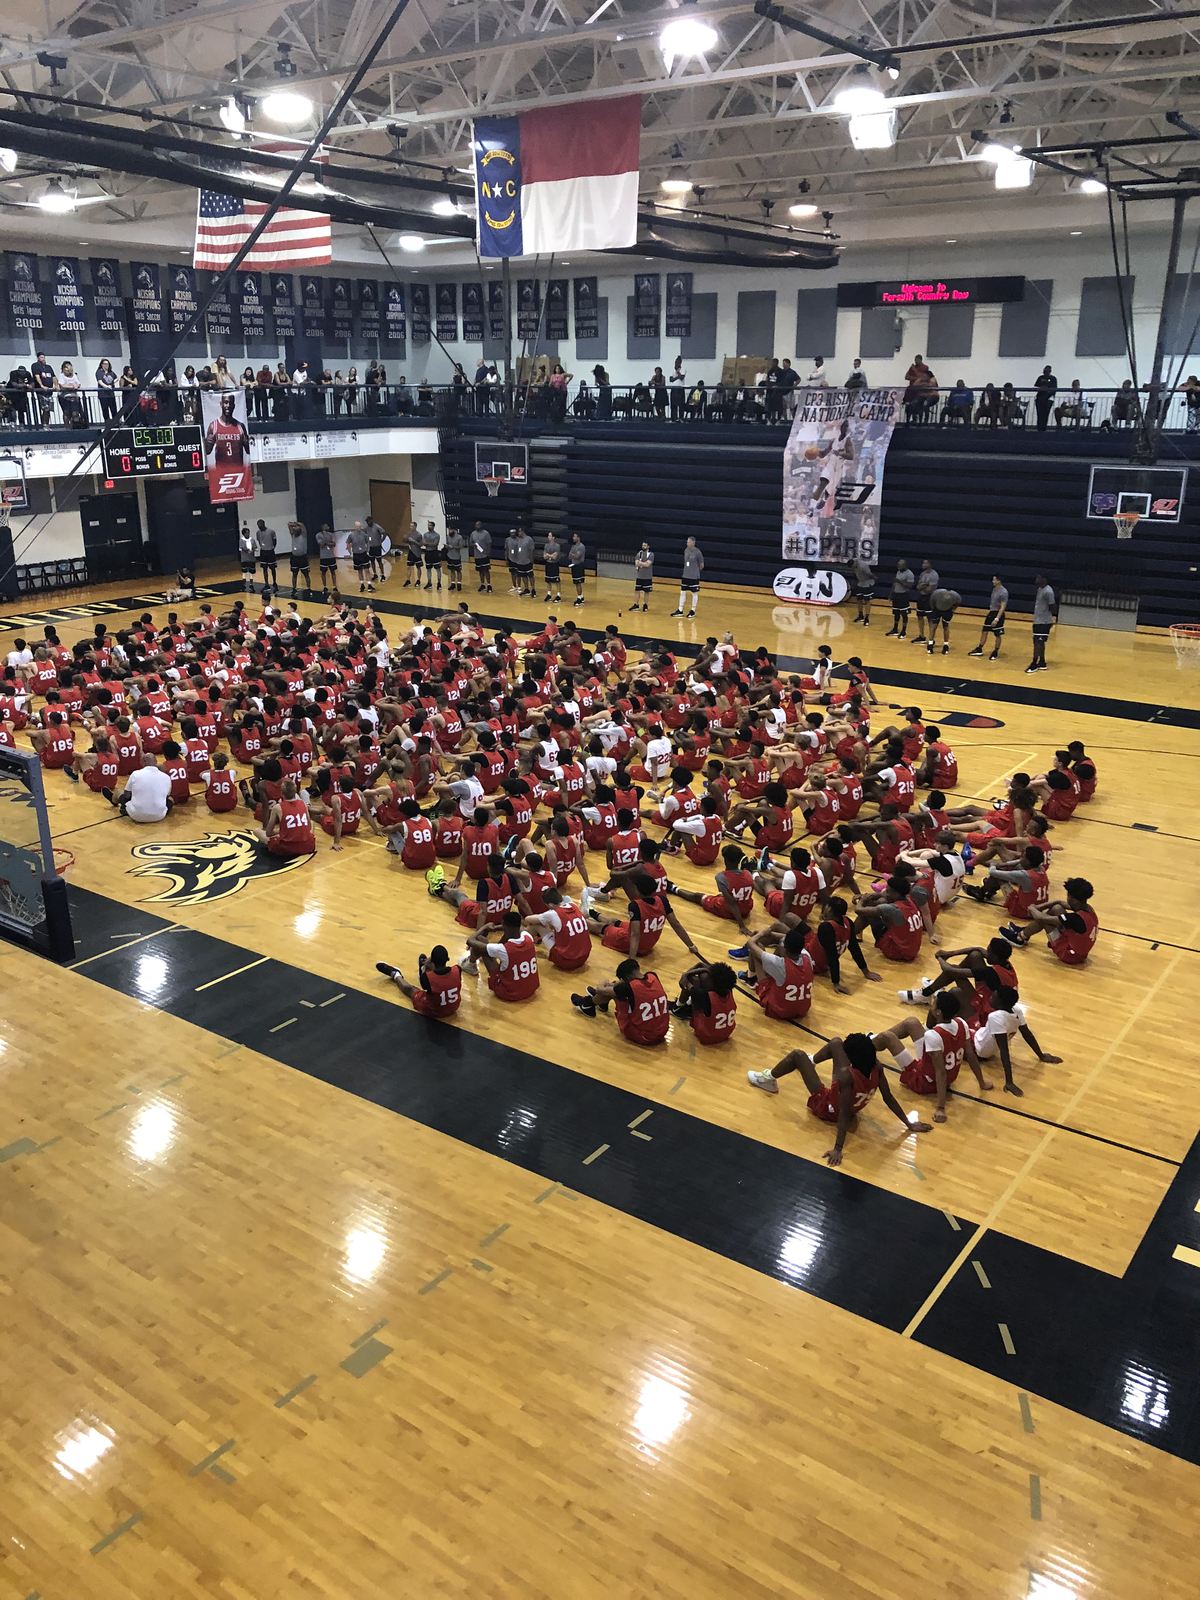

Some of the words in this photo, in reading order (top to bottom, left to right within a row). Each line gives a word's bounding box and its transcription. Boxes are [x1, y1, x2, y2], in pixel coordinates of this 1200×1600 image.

[482, 181, 492, 198] N
[505, 180, 517, 197] C
[901, 284, 934, 292] Welcome
[937, 282, 947, 291] to
[9, 291, 42, 304] CHAMPIONS
[53, 295, 84, 307] CHAMPIONS
[93, 296, 123, 307] CHAMPIONS
[882, 292, 914, 302] Forsyth
[917, 291, 950, 301] Country
[952, 289, 969, 300] Day
[133, 299, 161, 310] CHAMPIONS
[170, 300, 198, 311] CHAMPIONS
[239, 305, 264, 315] CHAMPIONS
[15, 317, 43, 329] 2000
[60, 320, 85, 331] 2000
[101, 321, 123, 330] 2001
[138, 322, 161, 332] 2001
[209, 325, 231, 335] 2004
[243, 327, 264, 336] 2005
[276, 327, 295, 337] 2006
[388, 331, 405, 339] 2006
[438, 332, 455, 340] 2007
[465, 332, 483, 341] 2007
[637, 327, 655, 337] 2015
[860, 390, 898, 405] STARS
[860, 403, 895, 421] CAMP
[109, 447, 131, 456] HOME
[177, 444, 201, 452] GUEST
[225, 442, 232, 456] 3
[121, 456, 131, 472] 0
[191, 452, 200, 467] 0
[39, 668, 57, 681] 203
[325, 708, 336, 720] 85
[146, 726, 161, 739] 31
[197, 725, 217, 738] 175
[53, 738, 73, 753] 185
[245, 738, 261, 751] 66
[120, 745, 137, 758] 97
[190, 749, 209, 763] 125
[101, 763, 117, 776] 80
[168, 767, 187, 781] 20
[212, 781, 231, 795] 36
[285, 812, 308, 829] 214
[341, 810, 361, 823] 154
[412, 828, 432, 845] 98
[443, 830, 461, 845] 27
[471, 841, 492, 856] 110
[615, 847, 639, 864] 127
[486, 894, 512, 914] 206
[642, 915, 665, 934] 142
[511, 956, 537, 982] 196
[439, 986, 459, 1007] 15
[638, 995, 668, 1023] 217
[714, 1009, 736, 1031] 26
[944, 1047, 965, 1071] 99
